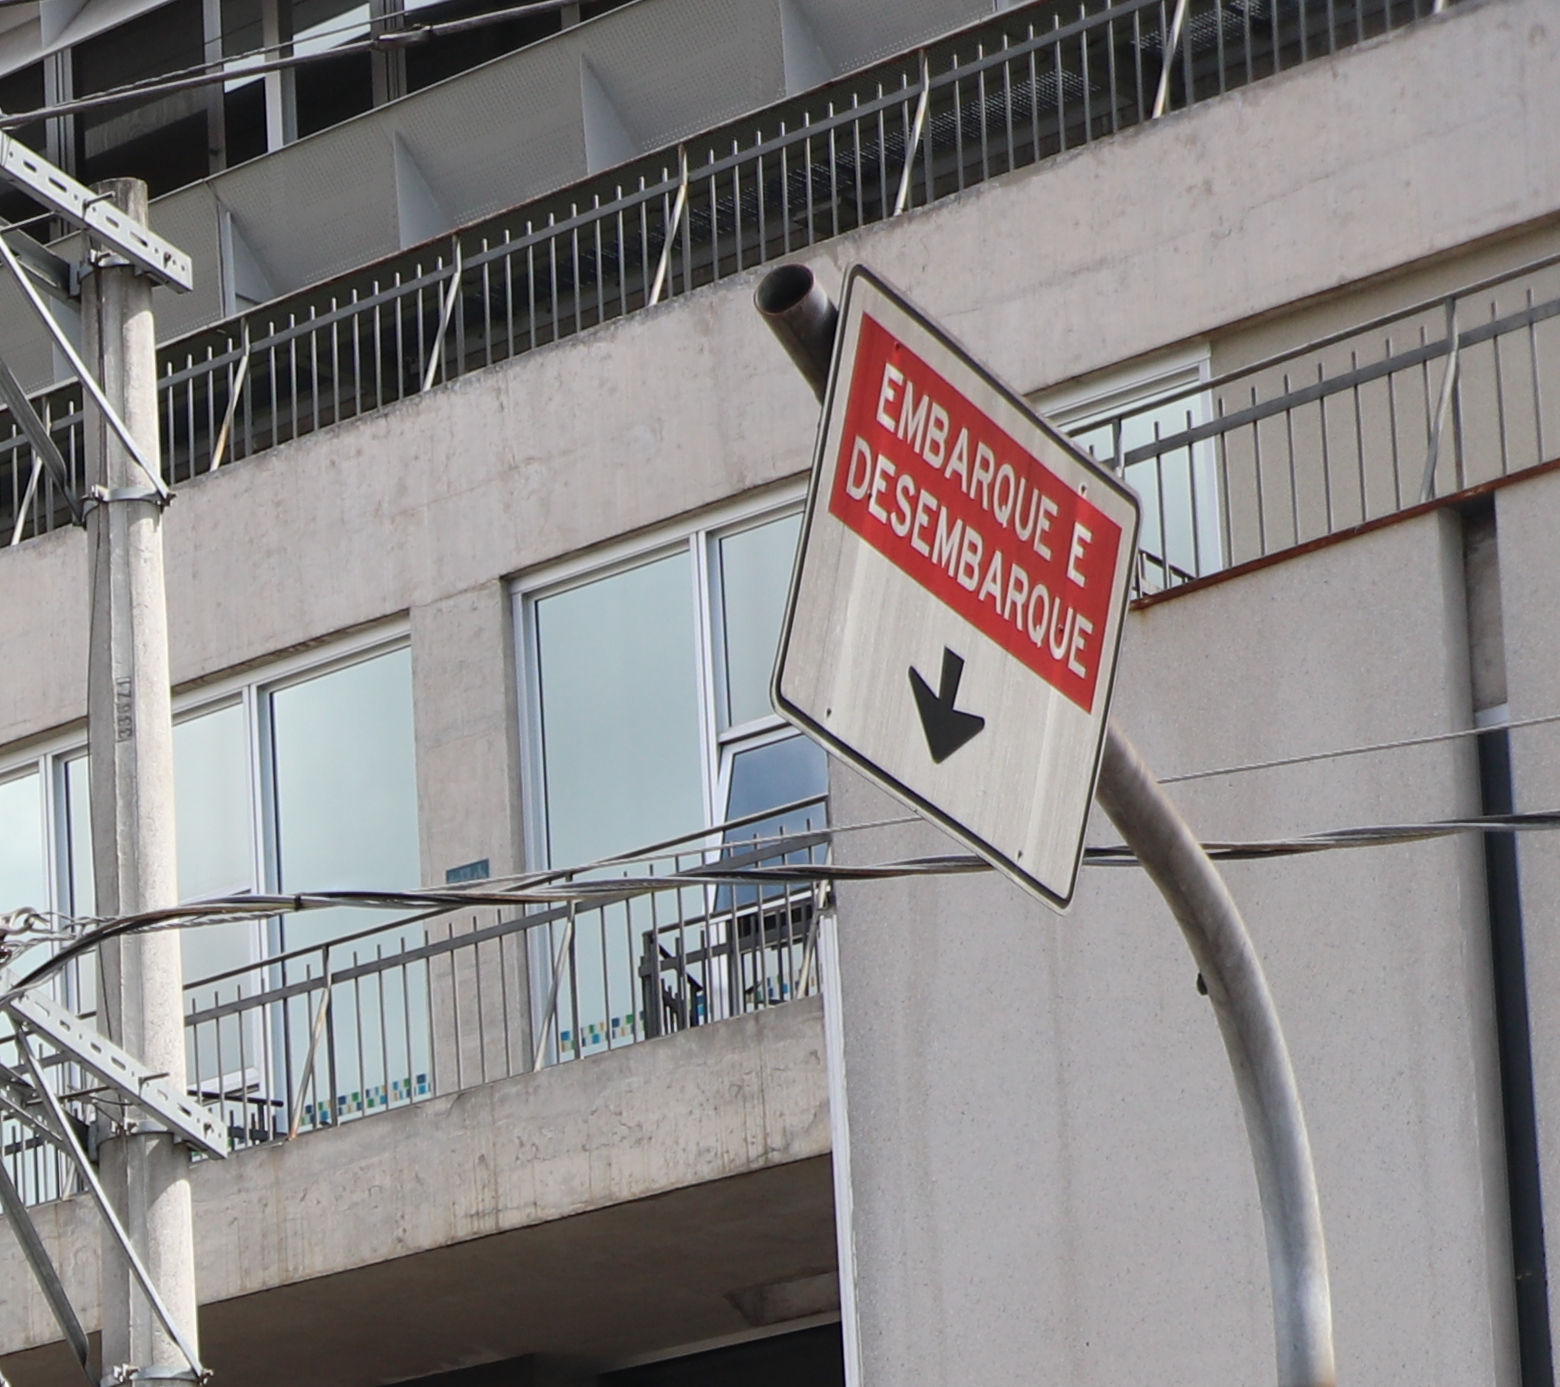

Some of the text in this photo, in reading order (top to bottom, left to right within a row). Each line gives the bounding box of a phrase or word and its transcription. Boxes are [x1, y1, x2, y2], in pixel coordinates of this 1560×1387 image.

[845, 434, 1094, 679] DESEMBARQUE
[875, 361, 1093, 589] EMBARQUE E
